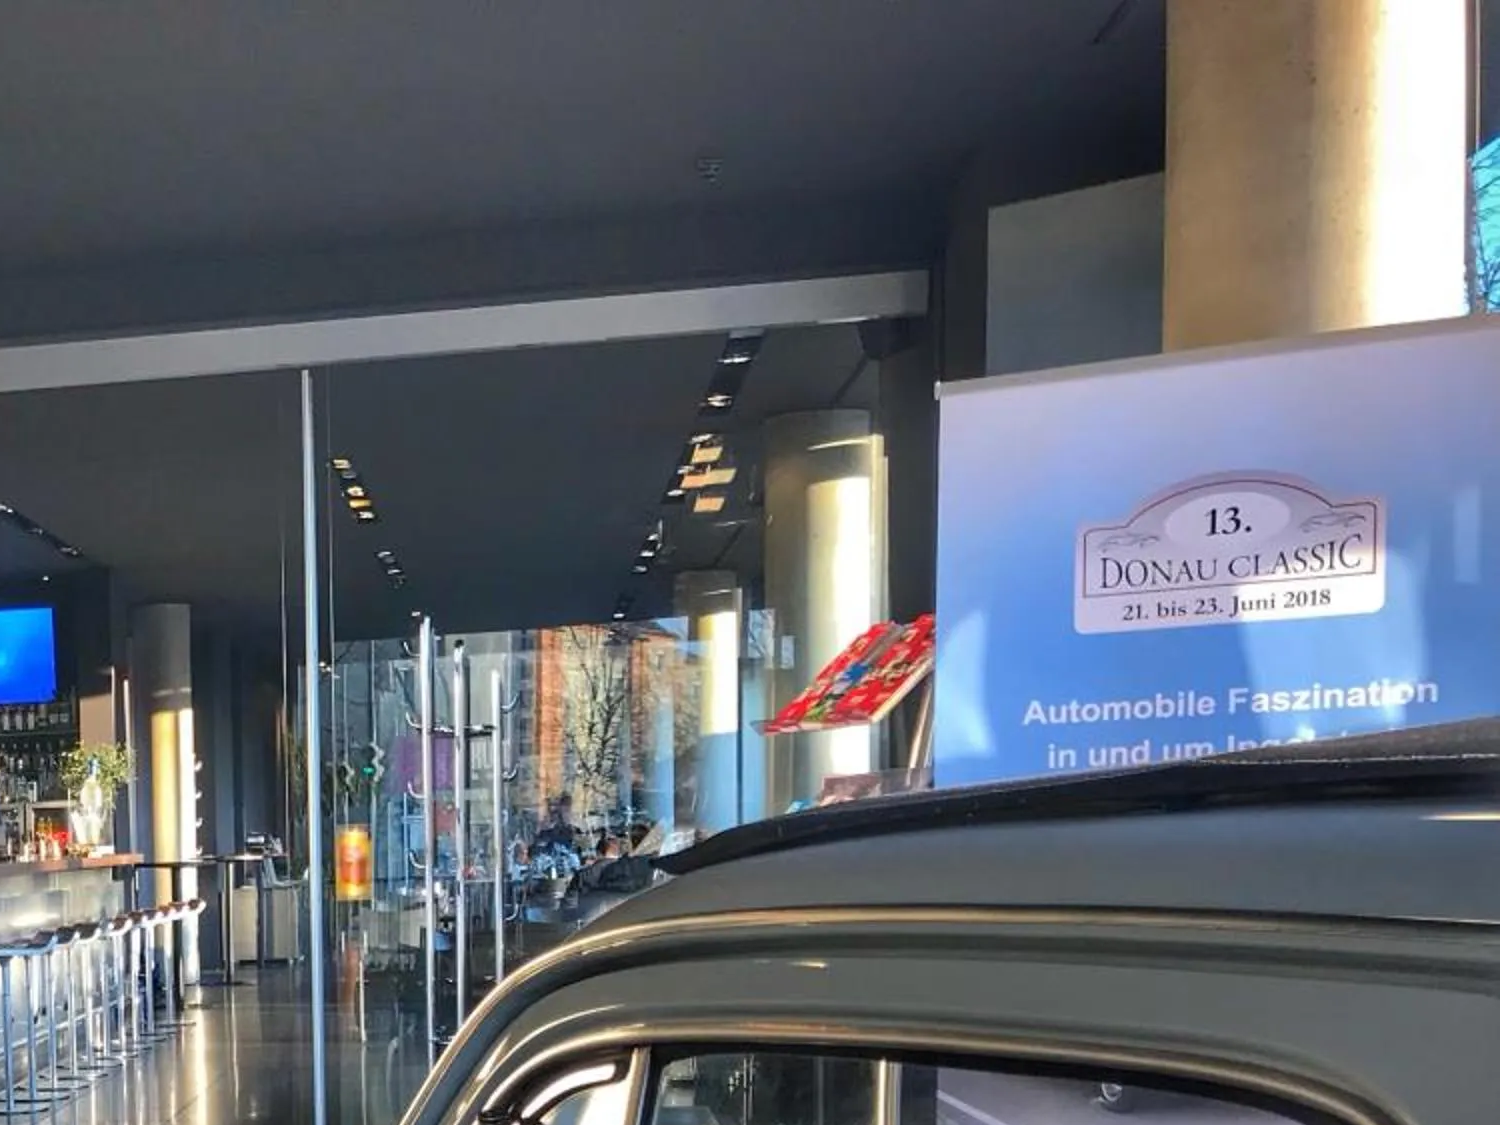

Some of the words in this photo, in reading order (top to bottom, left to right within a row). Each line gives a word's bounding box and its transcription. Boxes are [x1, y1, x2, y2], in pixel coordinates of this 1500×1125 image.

[1204, 506, 1252, 537] 13.
[1100, 556, 1218, 589] DONAU
[1227, 533, 1363, 579] CLASSIC
[1122, 603, 1149, 622] 21.
[1156, 601, 1187, 618] bis
[1193, 596, 1223, 616] 23.
[1228, 592, 1276, 618] Juni
[1283, 587, 1332, 609] 2018
[1022, 690, 1217, 727] Automobile
[1228, 678, 1439, 714] Faszination
[1047, 743, 1077, 770] in
[1088, 740, 1150, 767] und
